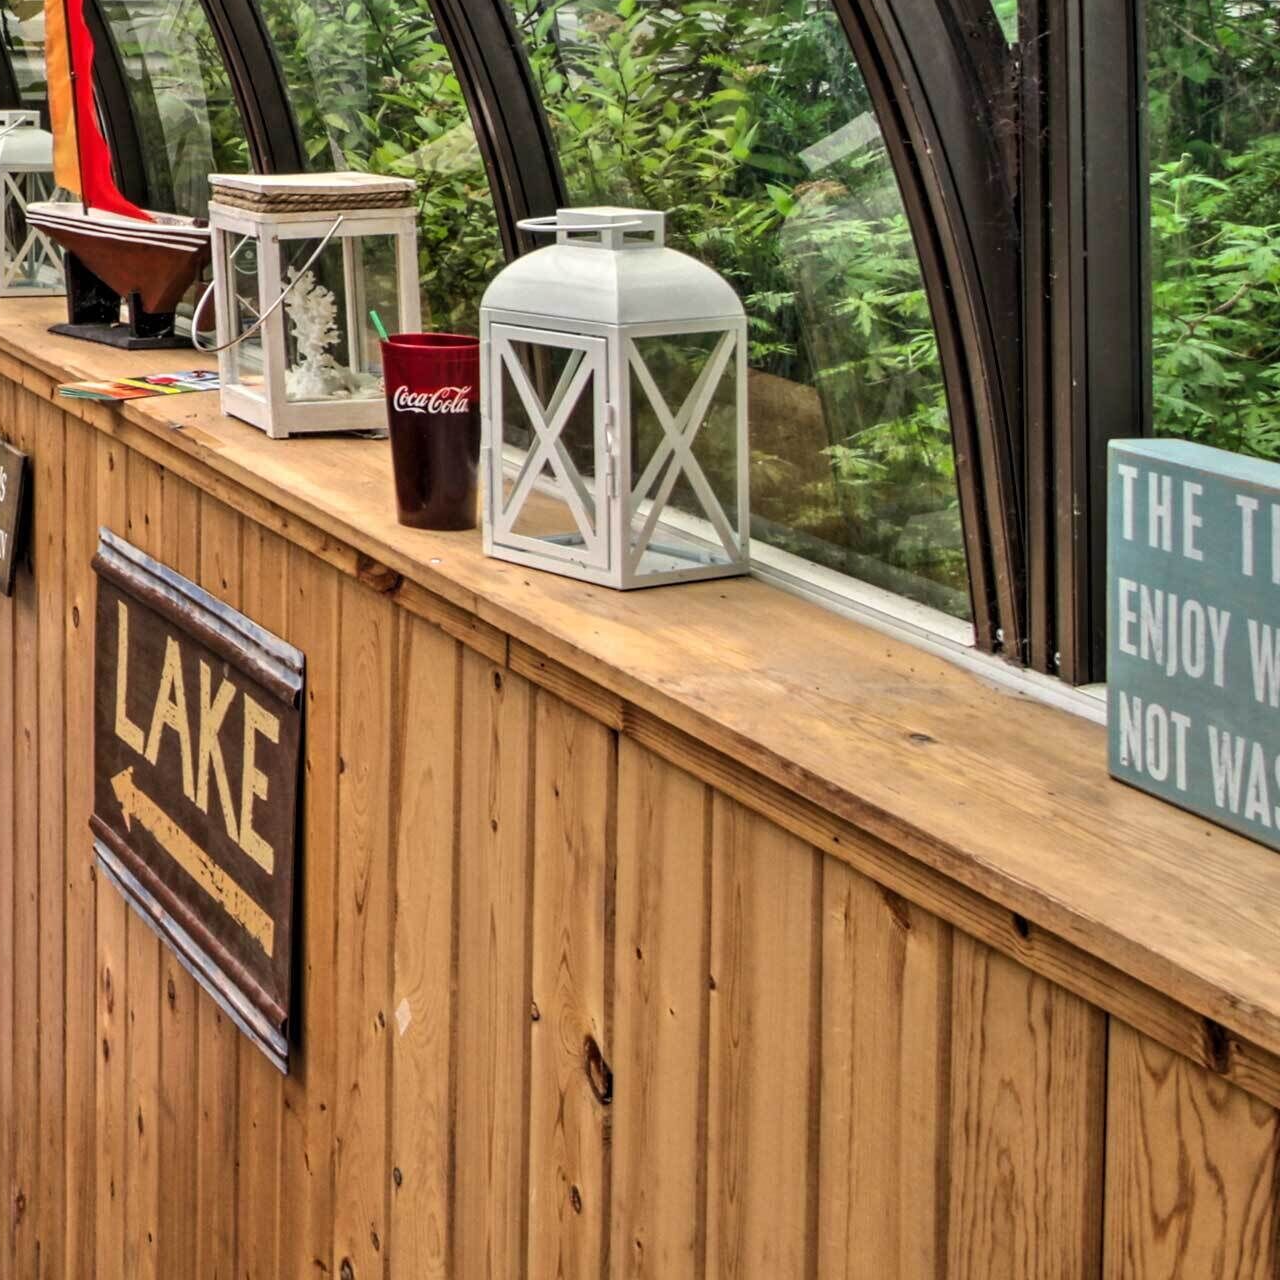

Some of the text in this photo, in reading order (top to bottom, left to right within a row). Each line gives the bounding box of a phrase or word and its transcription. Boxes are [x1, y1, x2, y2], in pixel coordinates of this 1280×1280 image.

[393, 385, 472, 413] Coca-Cola
[1117, 463, 1204, 562] THE
[1117, 576, 1231, 688] ENJOY
[114, 599, 281, 876] LAKE
[1118, 690, 1192, 791] NOT
